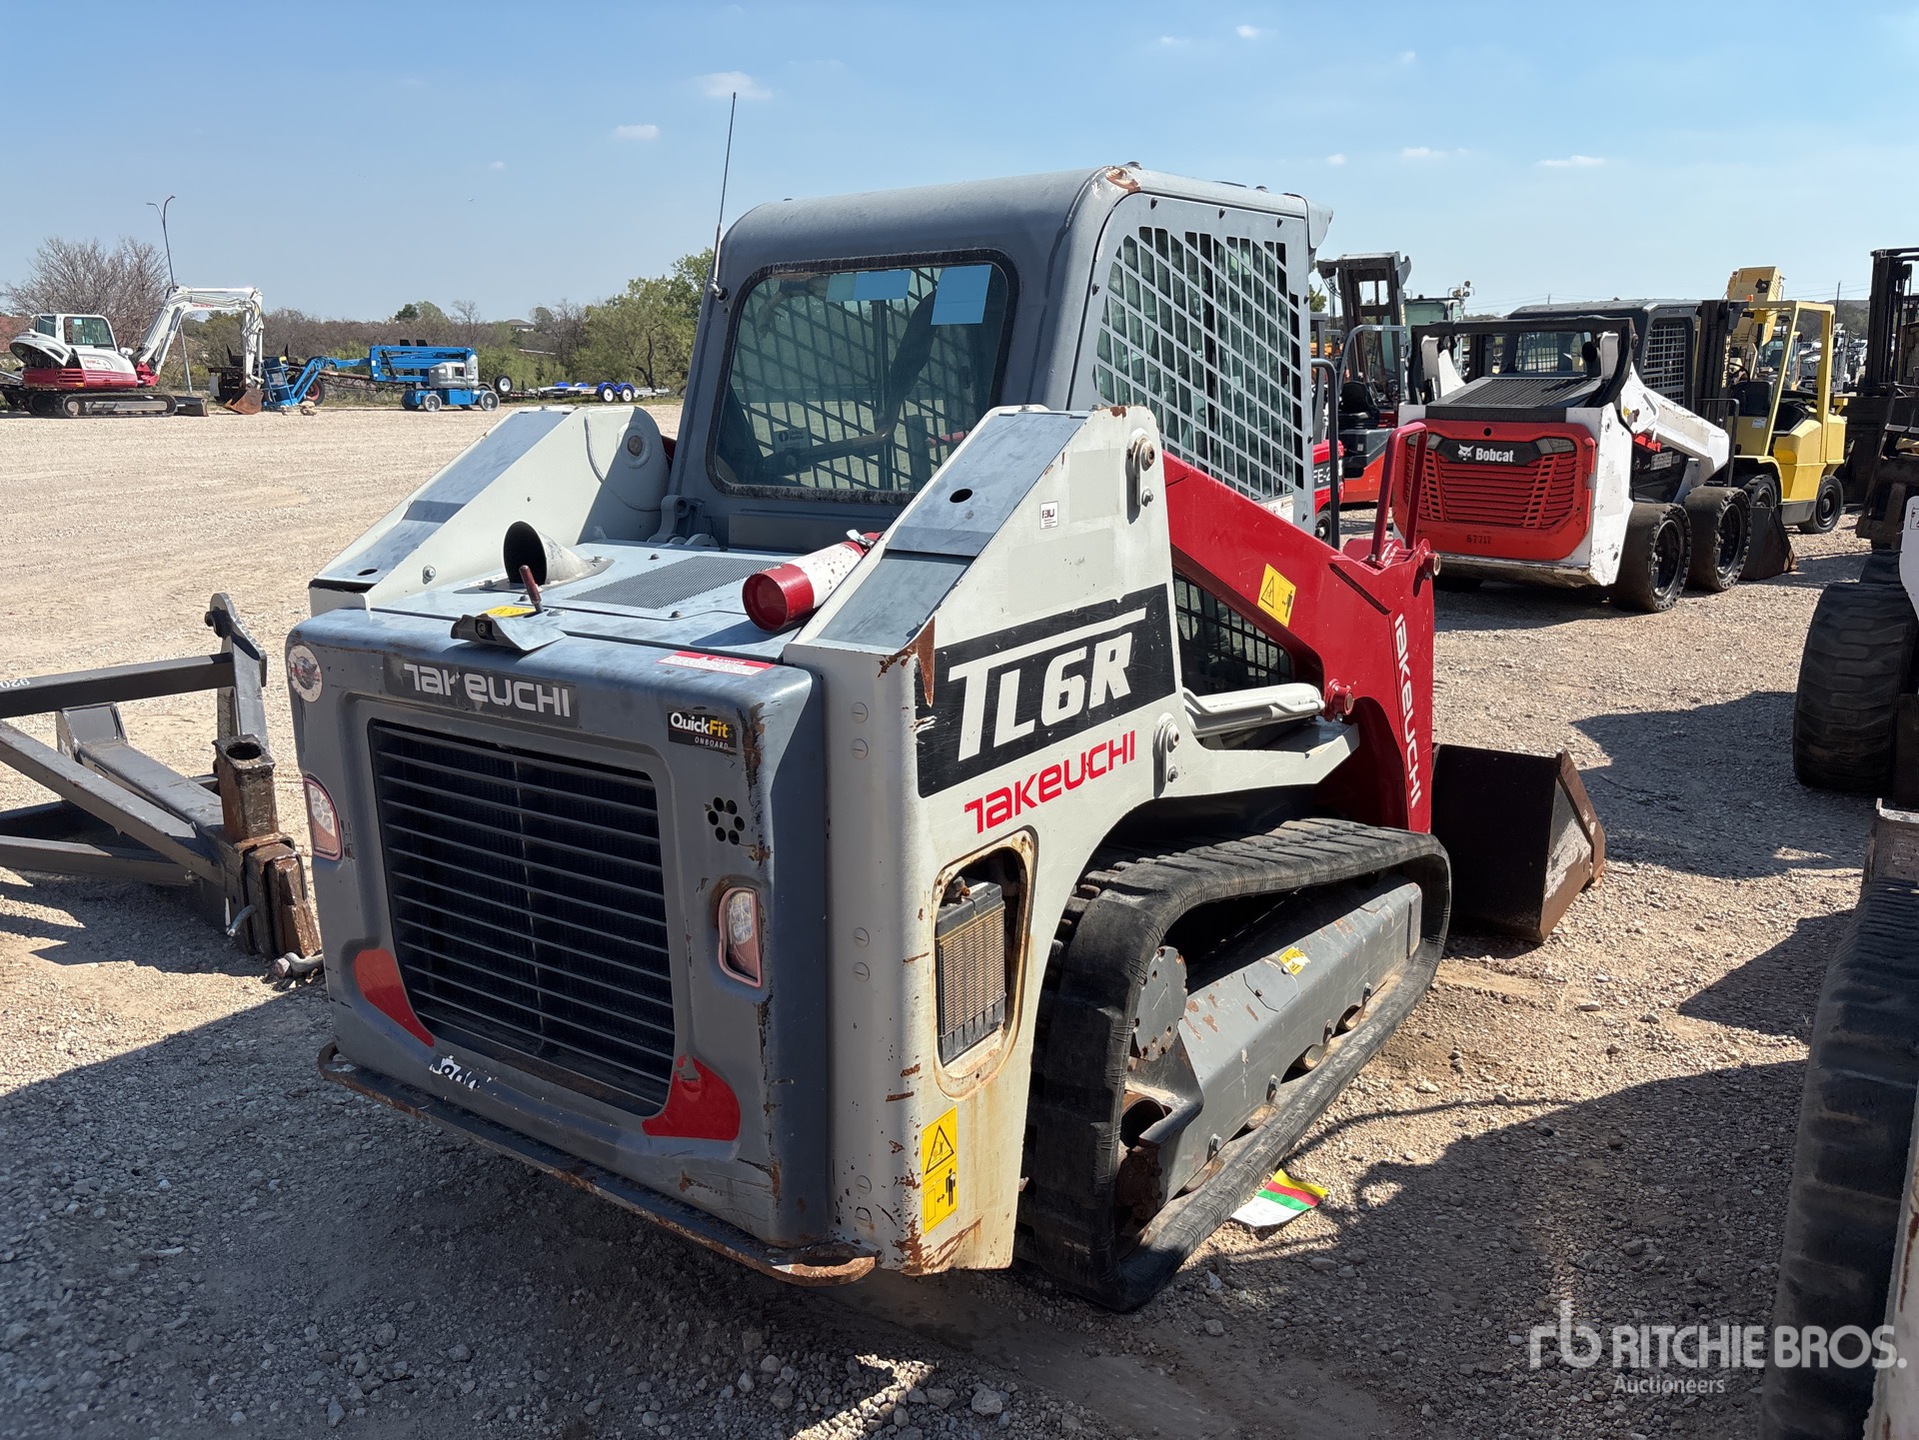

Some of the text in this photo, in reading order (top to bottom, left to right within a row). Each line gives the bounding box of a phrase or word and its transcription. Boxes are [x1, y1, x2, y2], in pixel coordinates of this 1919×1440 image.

[1721, 335, 1732, 389] HYSTER
[1475, 447, 1515, 463] Bobcat
[948, 607, 1147, 762] TL6R
[694, 736, 729, 750] ONBOARD
[964, 729, 1136, 834] TAKEUCHI
